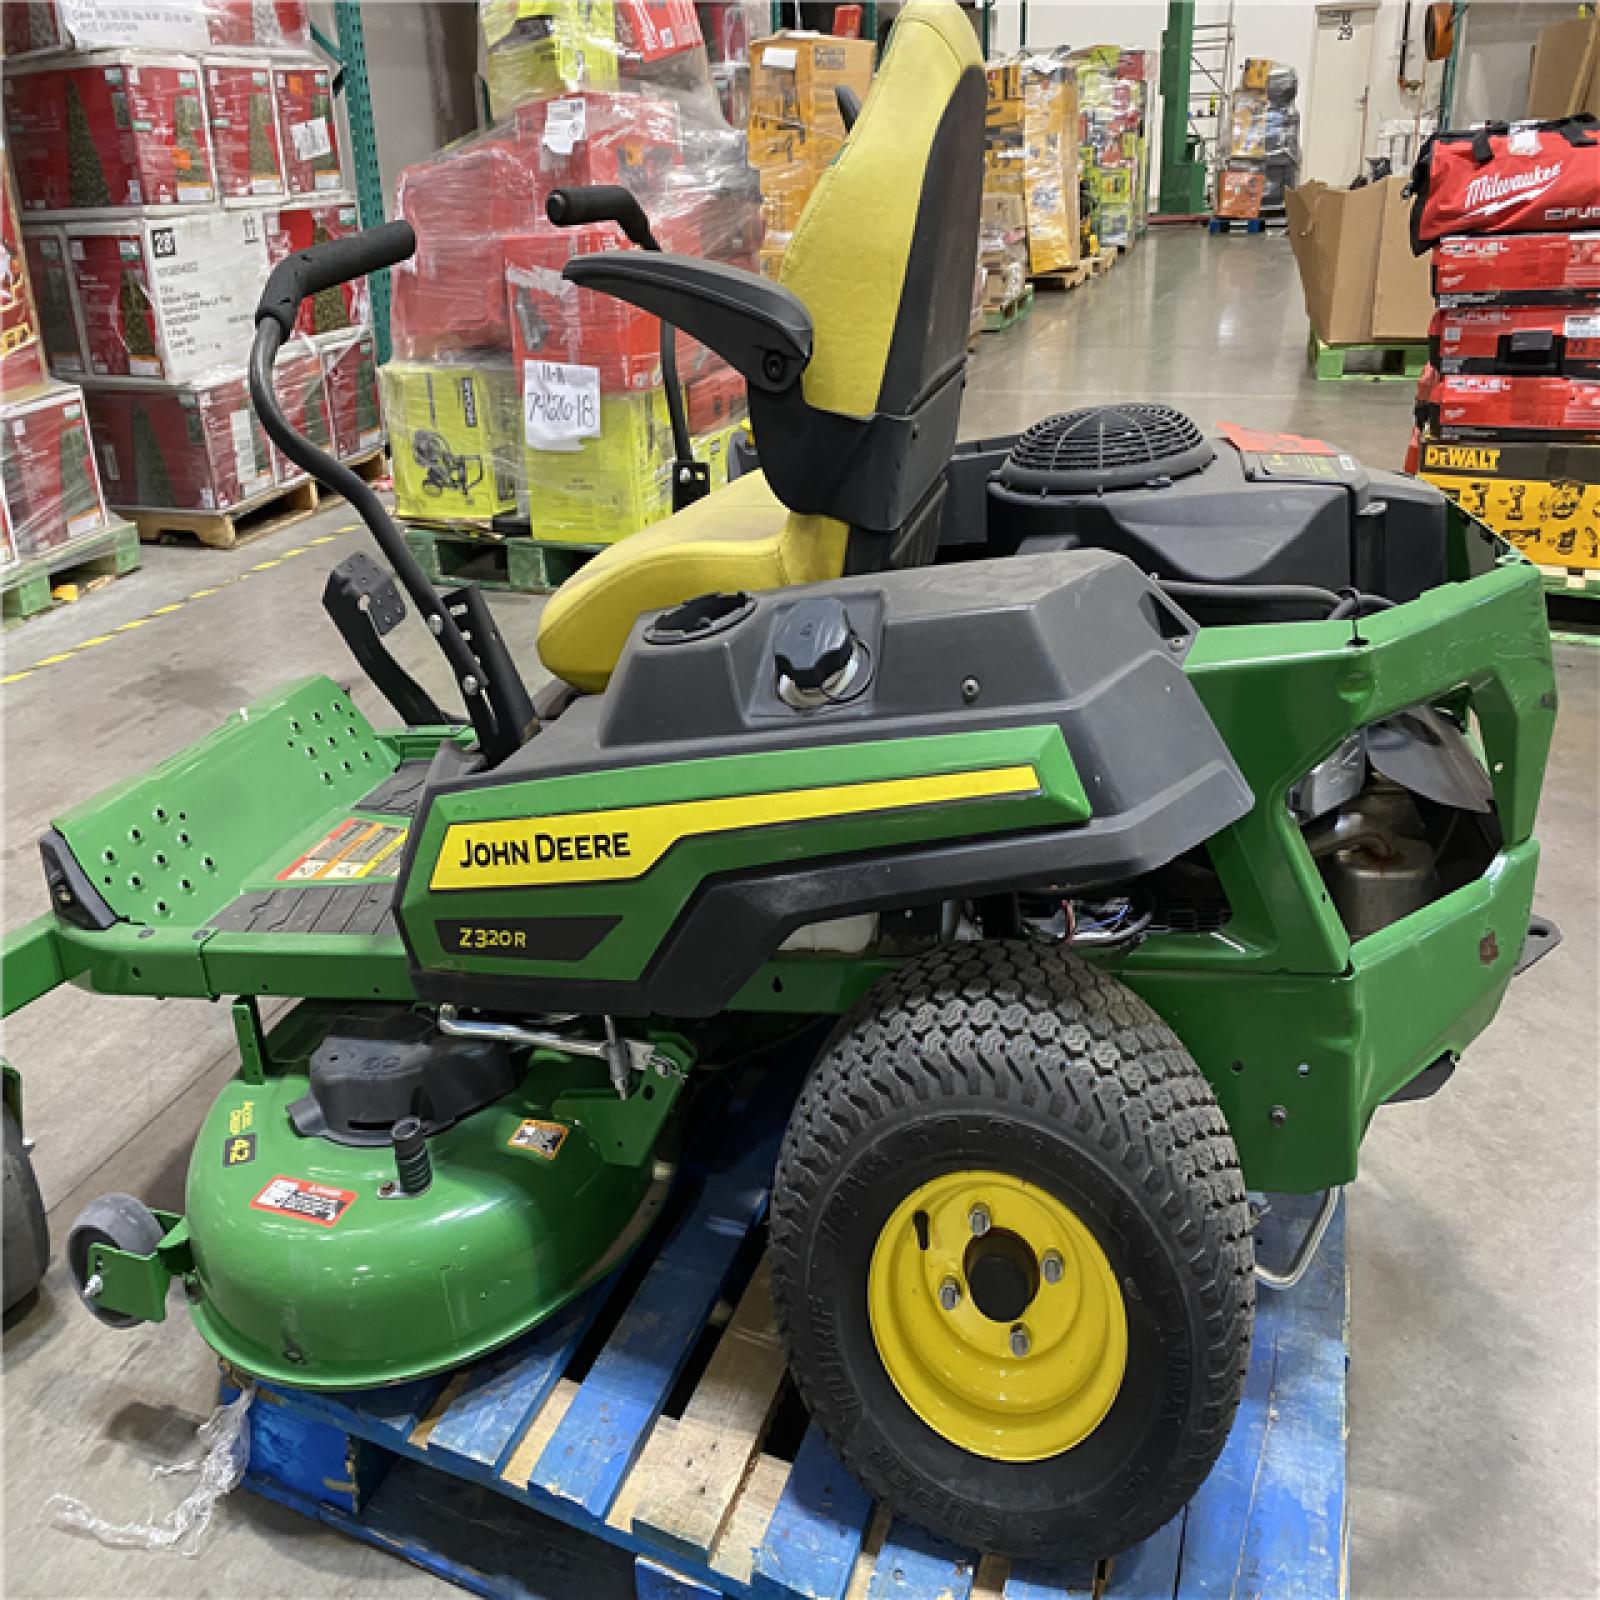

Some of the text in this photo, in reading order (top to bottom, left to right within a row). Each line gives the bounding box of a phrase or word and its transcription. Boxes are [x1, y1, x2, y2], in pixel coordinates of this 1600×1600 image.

[1464, 161, 1563, 209] Milwaukee
[459, 832, 631, 867] JOHN DEERE
